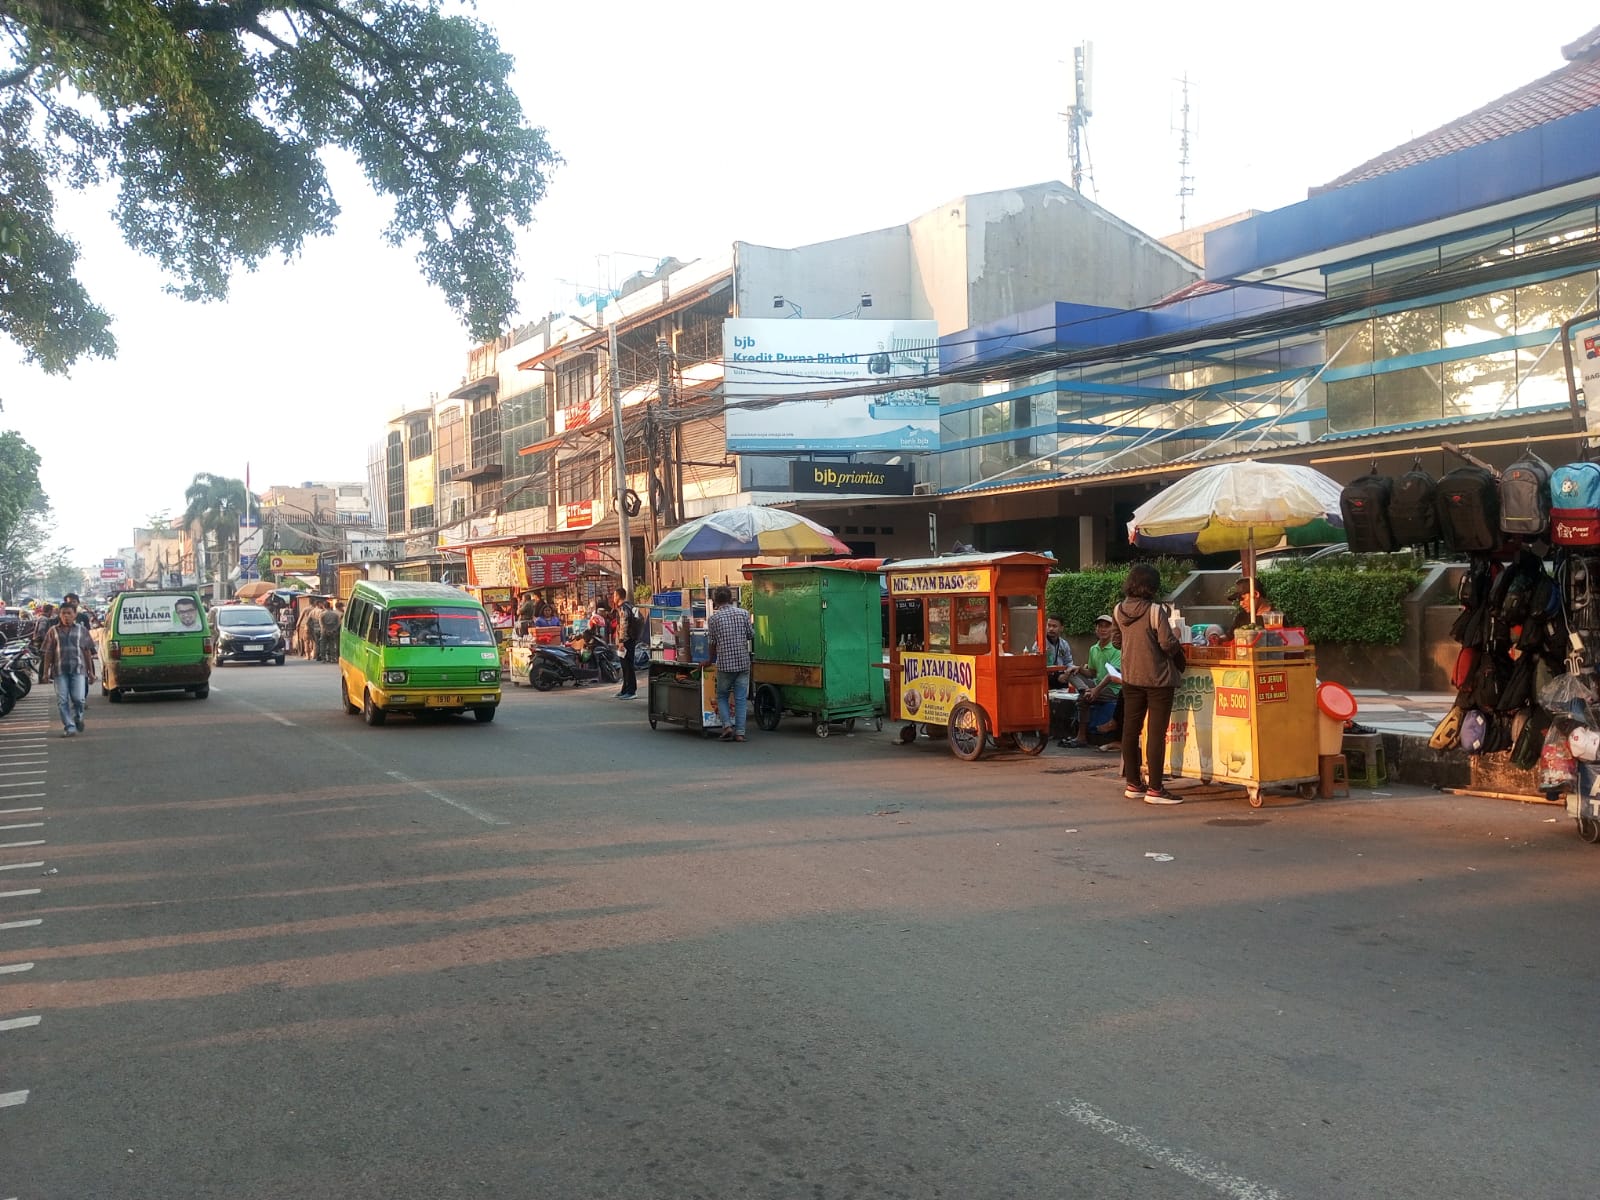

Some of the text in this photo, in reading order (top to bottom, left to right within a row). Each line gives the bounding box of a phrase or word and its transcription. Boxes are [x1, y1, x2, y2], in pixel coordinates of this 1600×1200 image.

[734, 336, 756, 350] bjb
[733, 352, 859, 365] Kredit Purna Bhakti
[814, 468, 885, 488] bjb prioritas
[893, 577, 909, 591] MIE
[911, 576, 936, 591] AYAM
[938, 575, 964, 590] BASO
[123, 611, 171, 621] MAULANA
[904, 658, 972, 690] MIE AYAM BASO
[1179, 675, 1213, 693] ERUK
[1218, 693, 1247, 710] Rp. 5000
